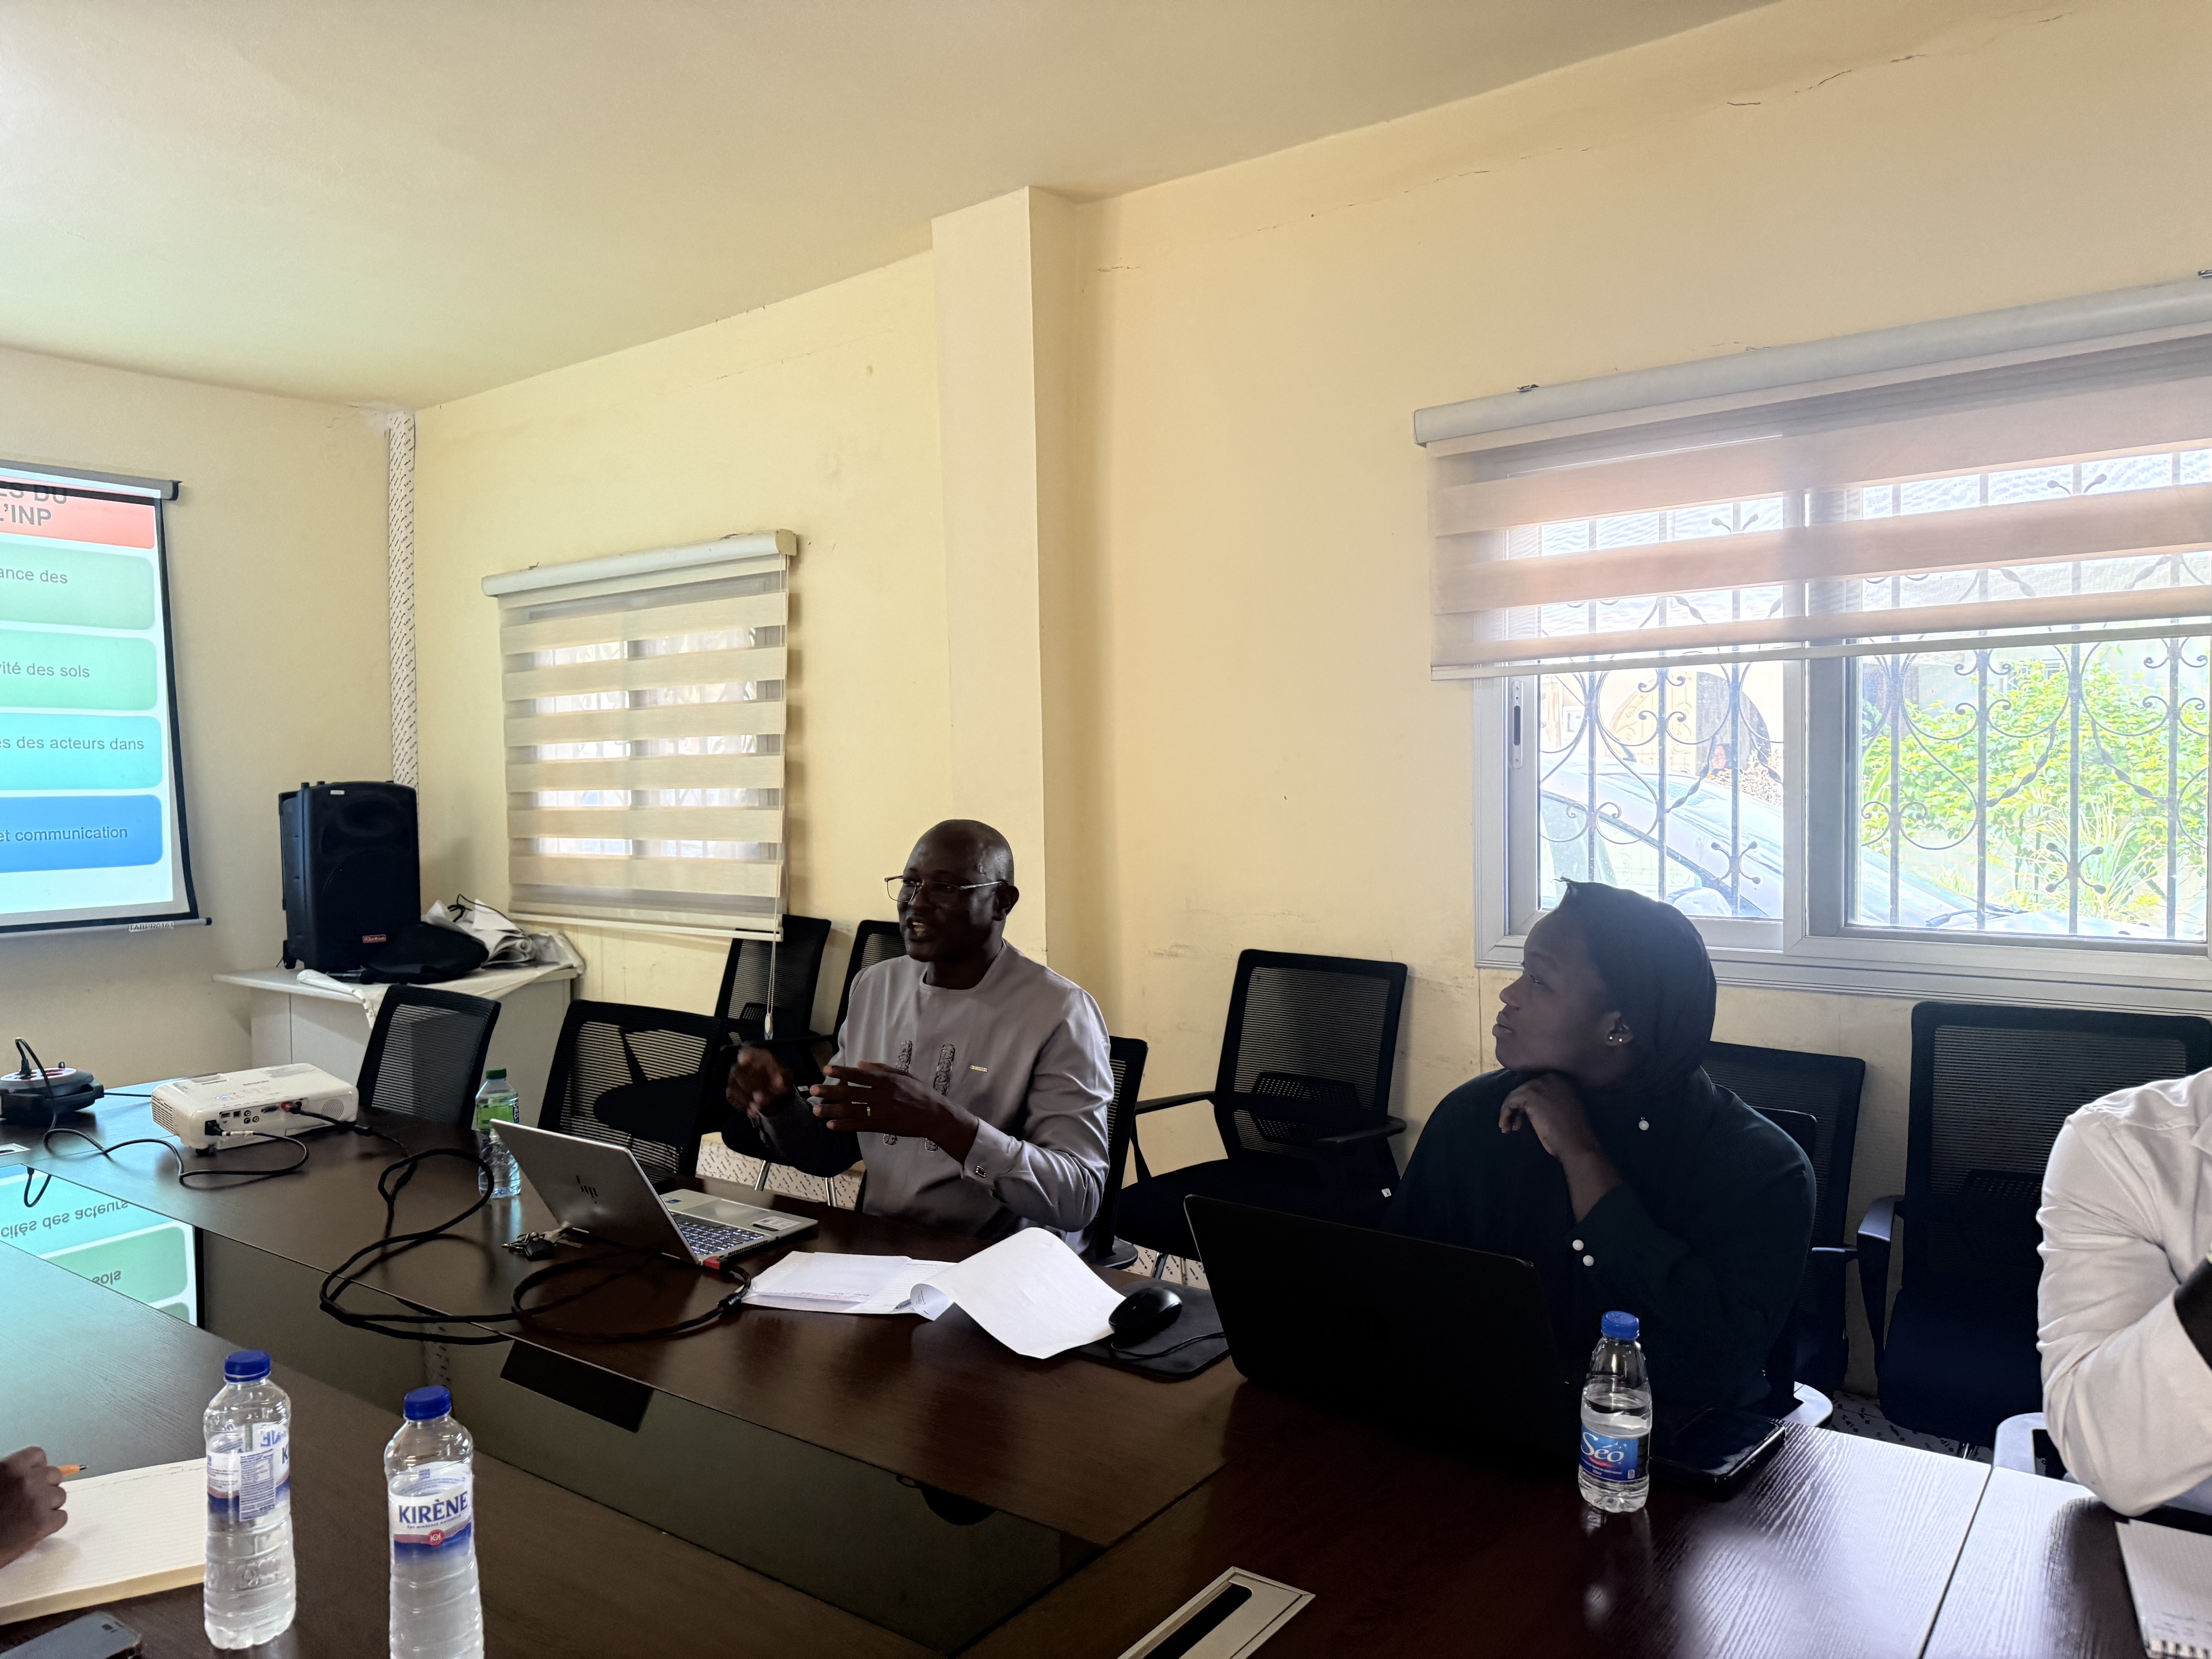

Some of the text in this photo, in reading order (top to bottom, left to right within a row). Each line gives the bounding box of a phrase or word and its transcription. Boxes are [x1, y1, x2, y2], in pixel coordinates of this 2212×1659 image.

[0, 503, 51, 526] 'INP
[40, 570, 68, 584] des
[0, 661, 90, 678] ité des sols
[17, 736, 44, 749] des
[50, 737, 105, 750] acteurs
[110, 738, 144, 750] dans
[15, 826, 127, 842] communication
[398, 1490, 468, 1524] KIRÈNE
